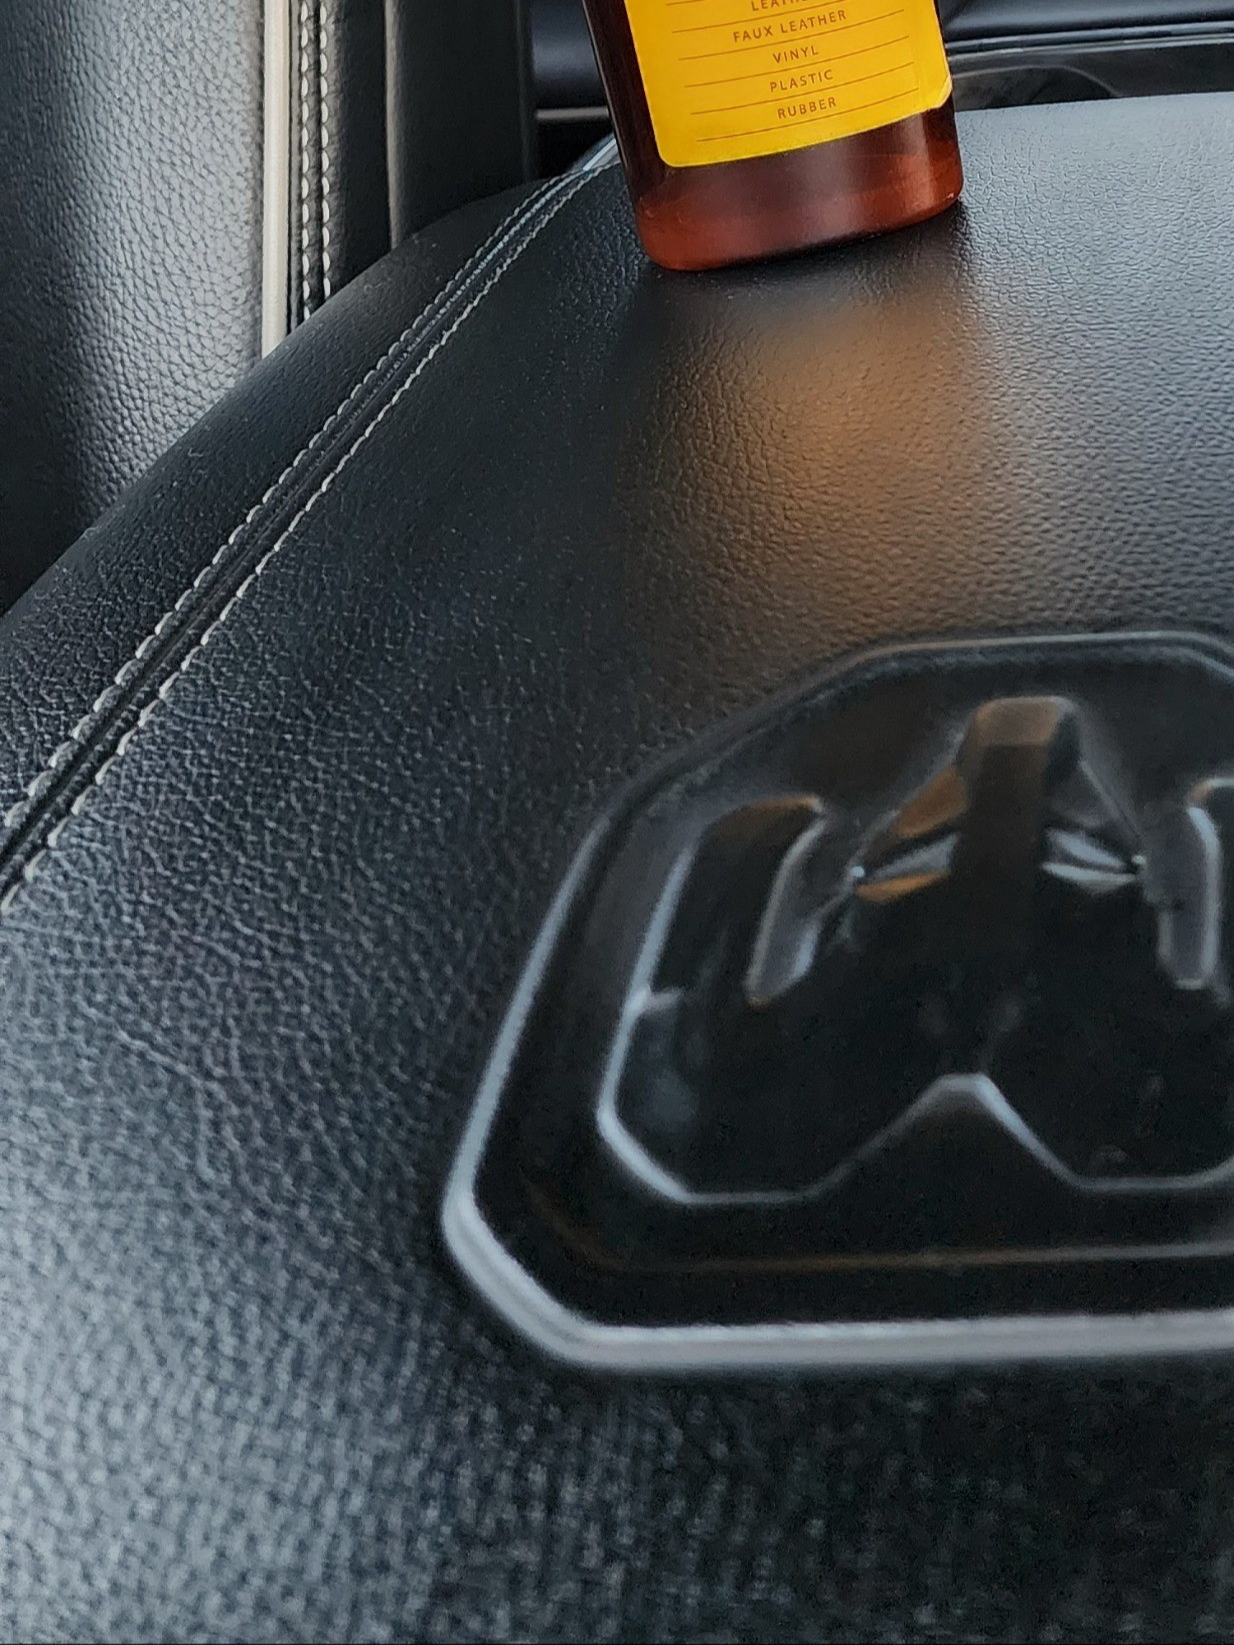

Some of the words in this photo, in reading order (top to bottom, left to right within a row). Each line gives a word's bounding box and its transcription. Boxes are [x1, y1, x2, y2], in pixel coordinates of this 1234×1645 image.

[733, 26, 773, 42] FAUX
[780, 10, 847, 34] LEATHER
[773, 45, 819, 64] VINYL
[770, 70, 833, 92] PLASTIC
[777, 97, 836, 119] RUBBER
